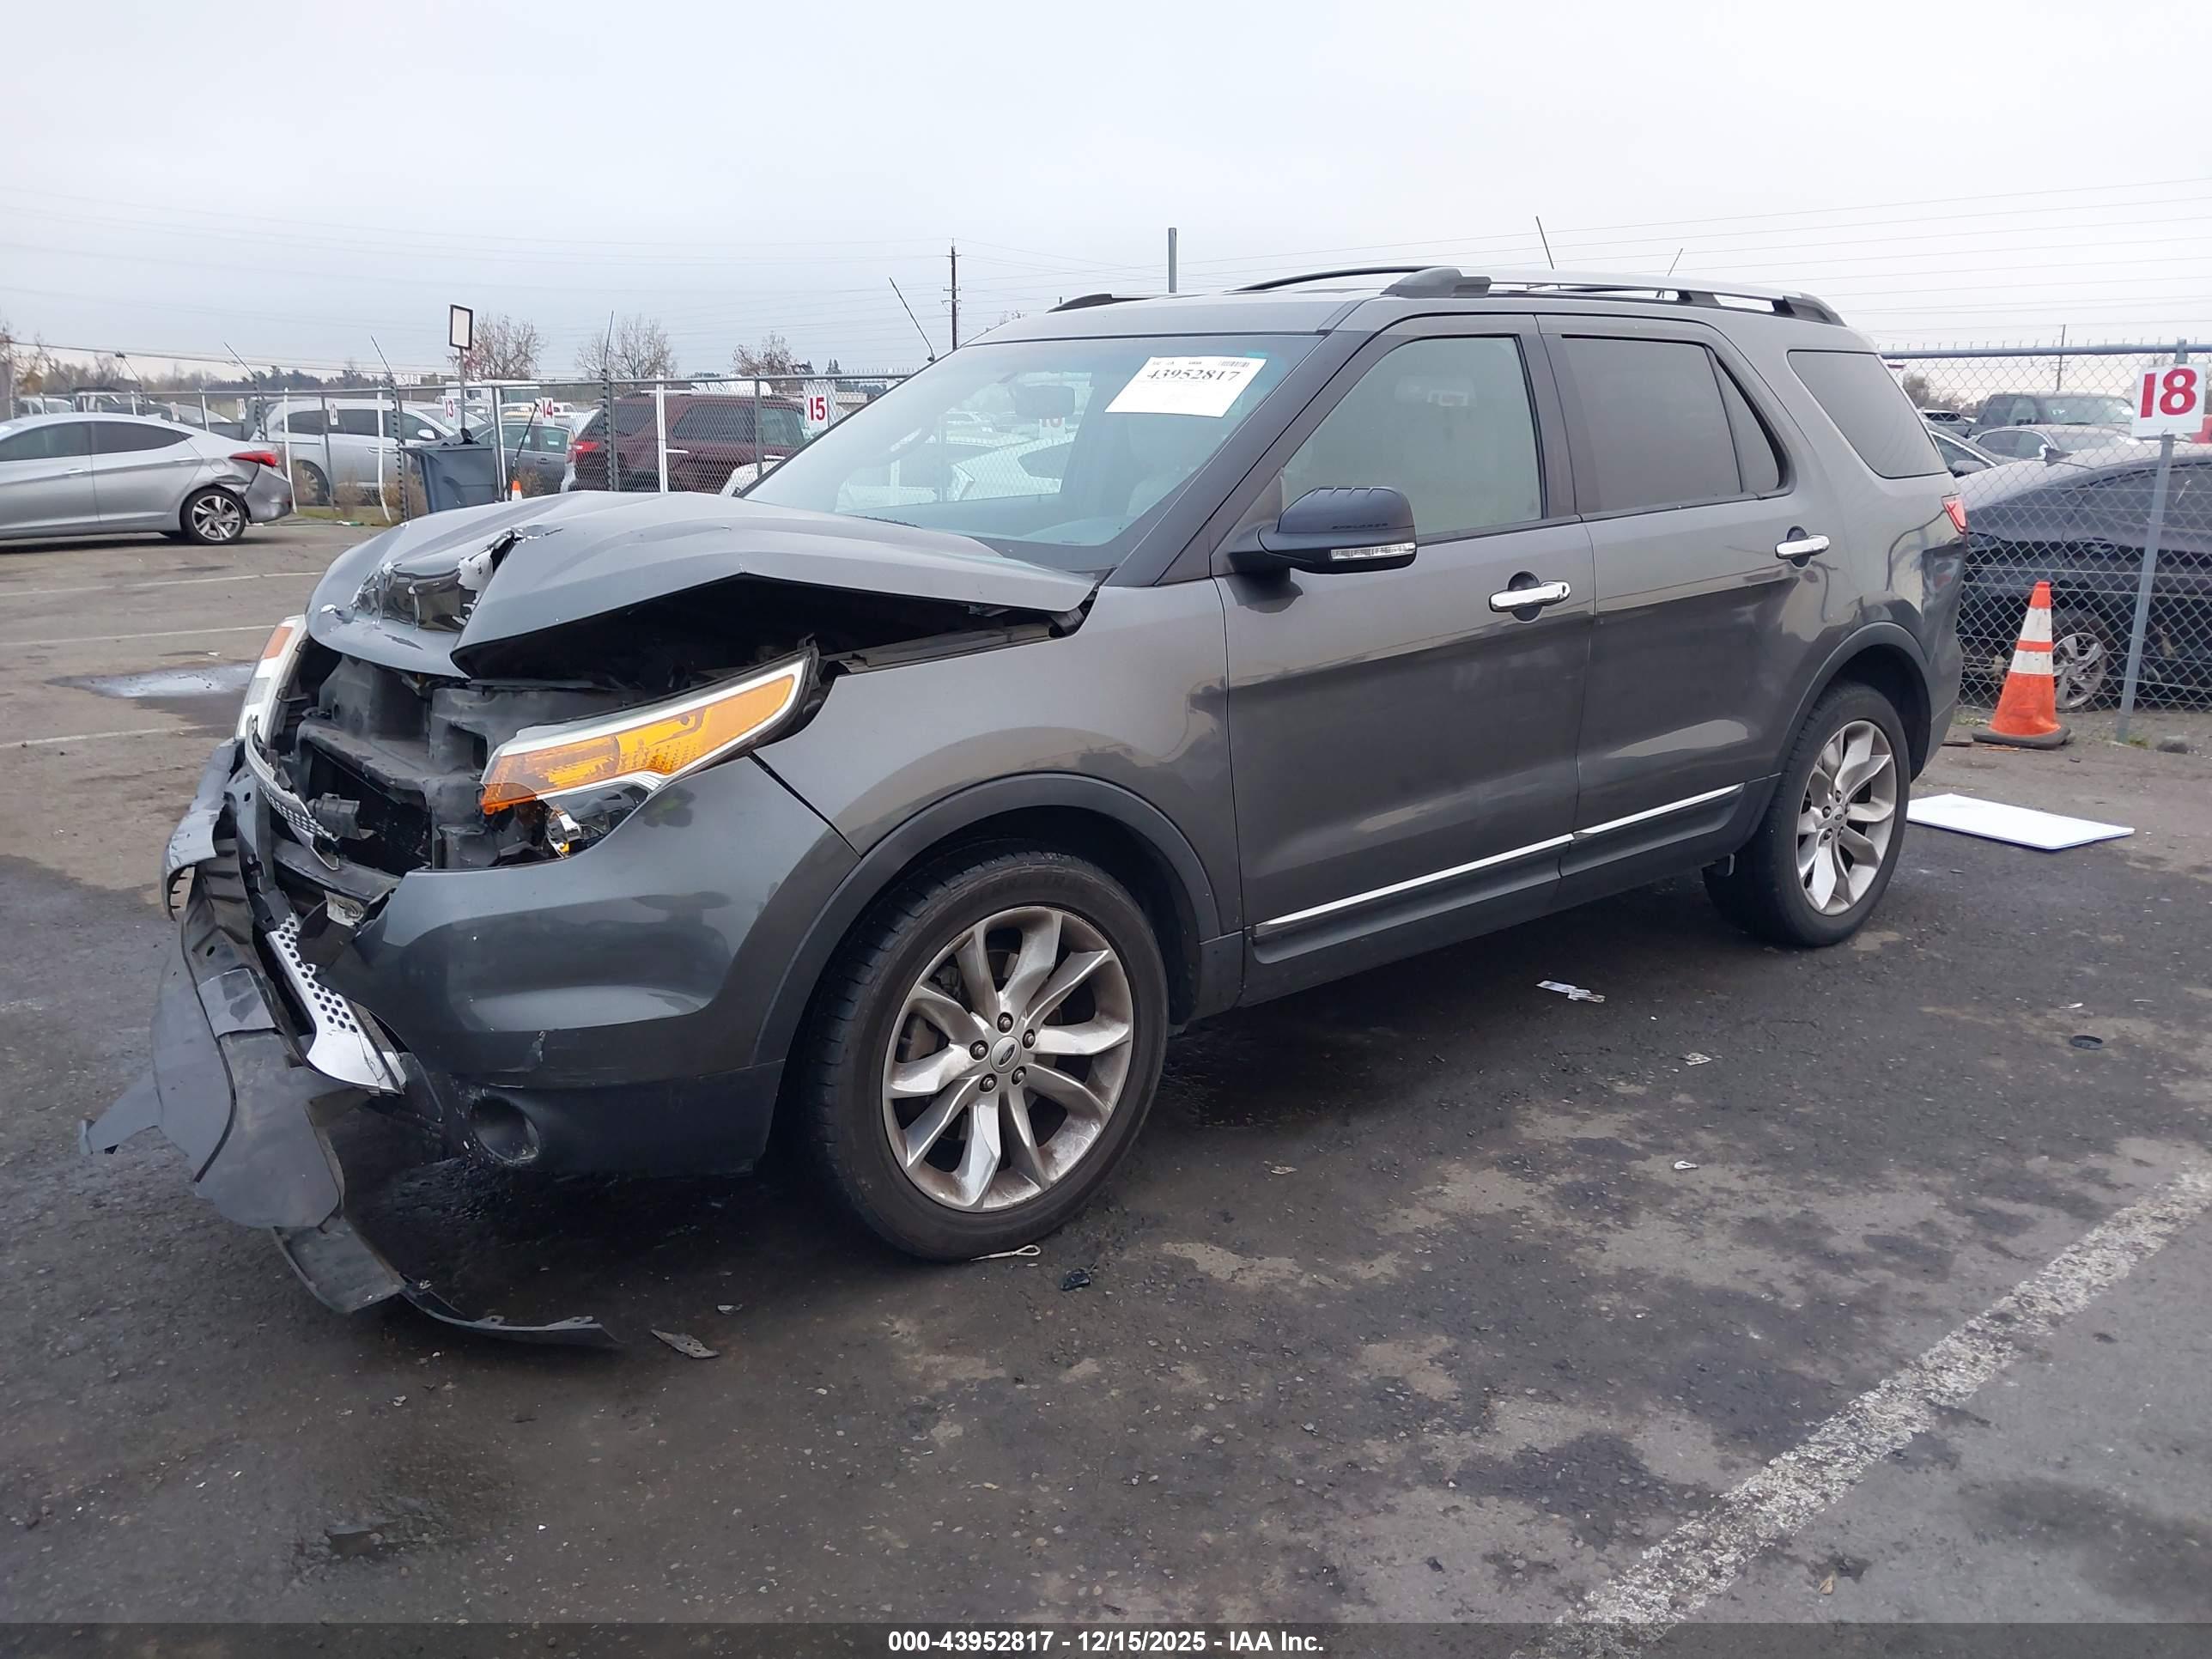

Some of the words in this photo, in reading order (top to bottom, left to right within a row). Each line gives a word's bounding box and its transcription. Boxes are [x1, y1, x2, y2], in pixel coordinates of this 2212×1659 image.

[1147, 368, 1242, 381] 43952817
[2140, 368, 2197, 418] 18
[445, 399, 454, 418] 13
[542, 399, 554, 419] 14
[810, 397, 825, 421] 15
